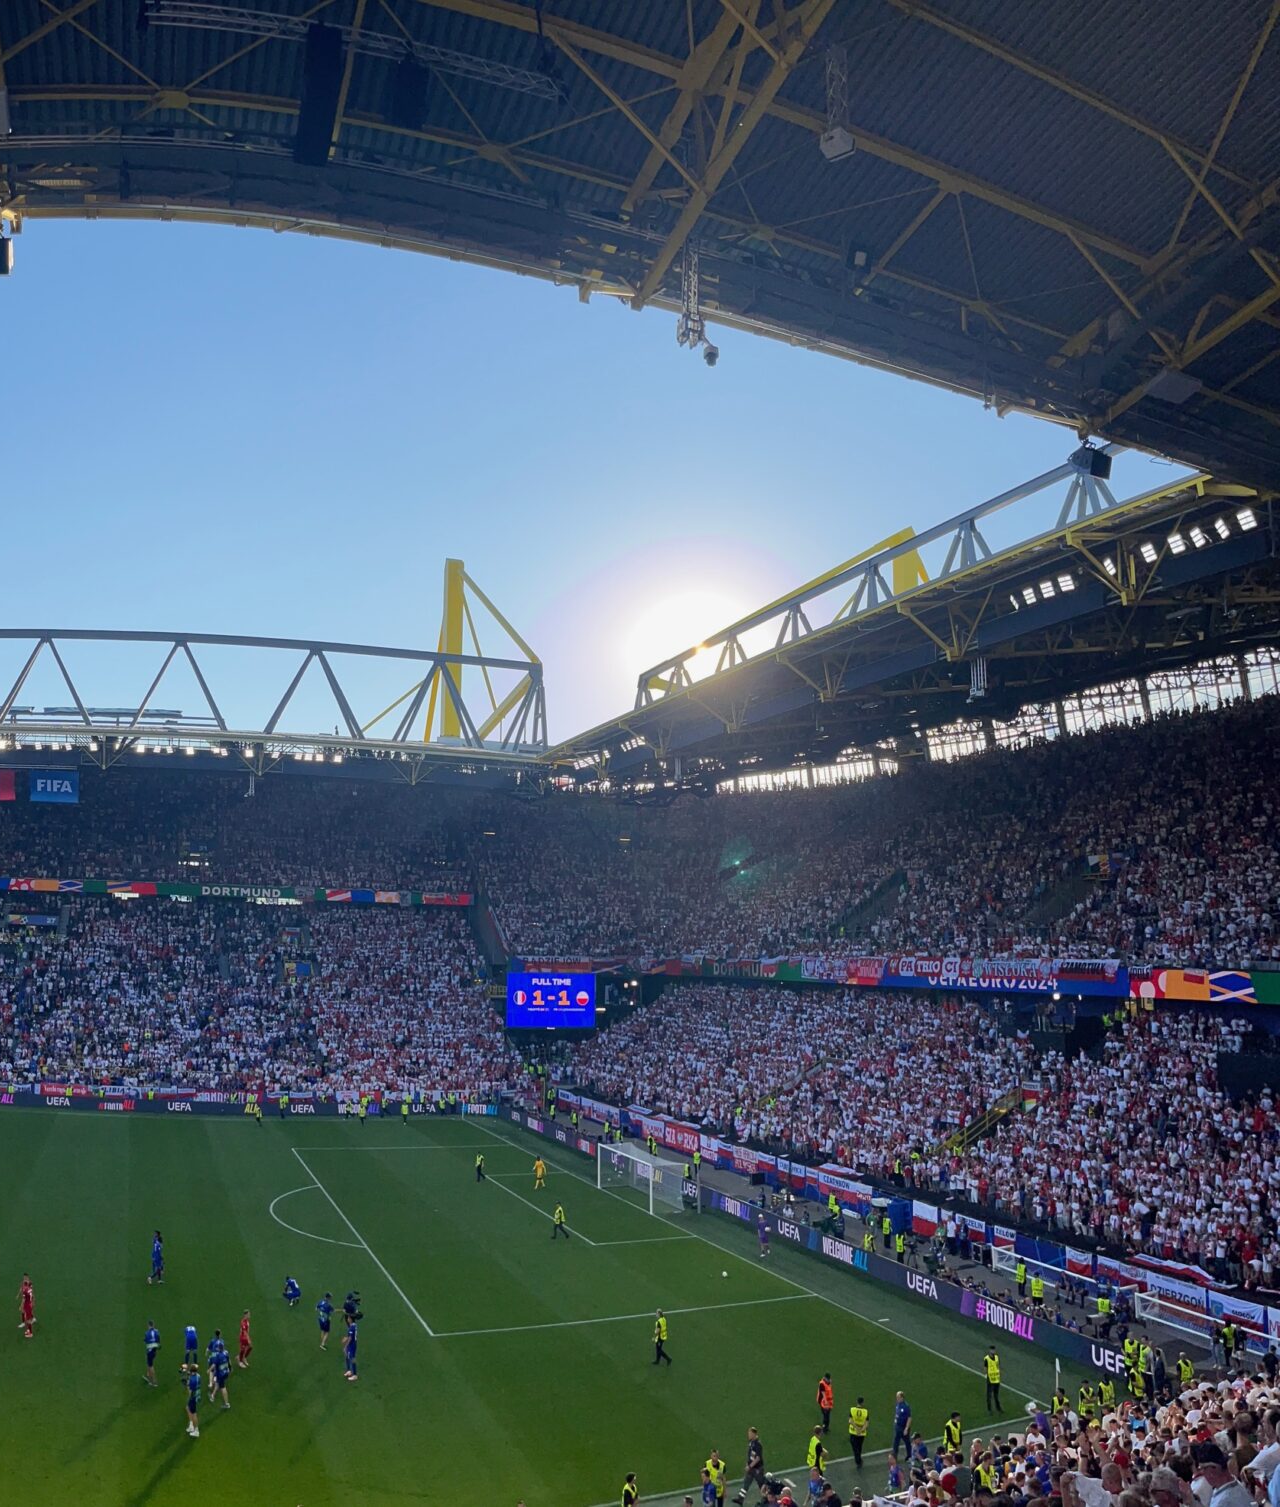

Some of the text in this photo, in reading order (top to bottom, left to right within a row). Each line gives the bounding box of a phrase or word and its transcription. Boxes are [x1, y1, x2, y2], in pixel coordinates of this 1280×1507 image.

[36, 779, 72, 793] FIFA
[202, 886, 281, 898] DORTMUND
[531, 978, 572, 986] FULL TIME
[1, 1093, 14, 1104] ALL
[46, 1096, 71, 1107] UEFA
[167, 1102, 192, 1112] UEFA
[290, 1104, 315, 1114] UEFA
[555, 1129, 567, 1143] UEFA
[778, 1219, 801, 1242] UEFA
[822, 1235, 868, 1272] WELCOME ALL
[906, 1271, 938, 1300] UEFA
[975, 1298, 1034, 1341] #FOOTBALL
[1091, 1344, 1128, 1376] UEF
